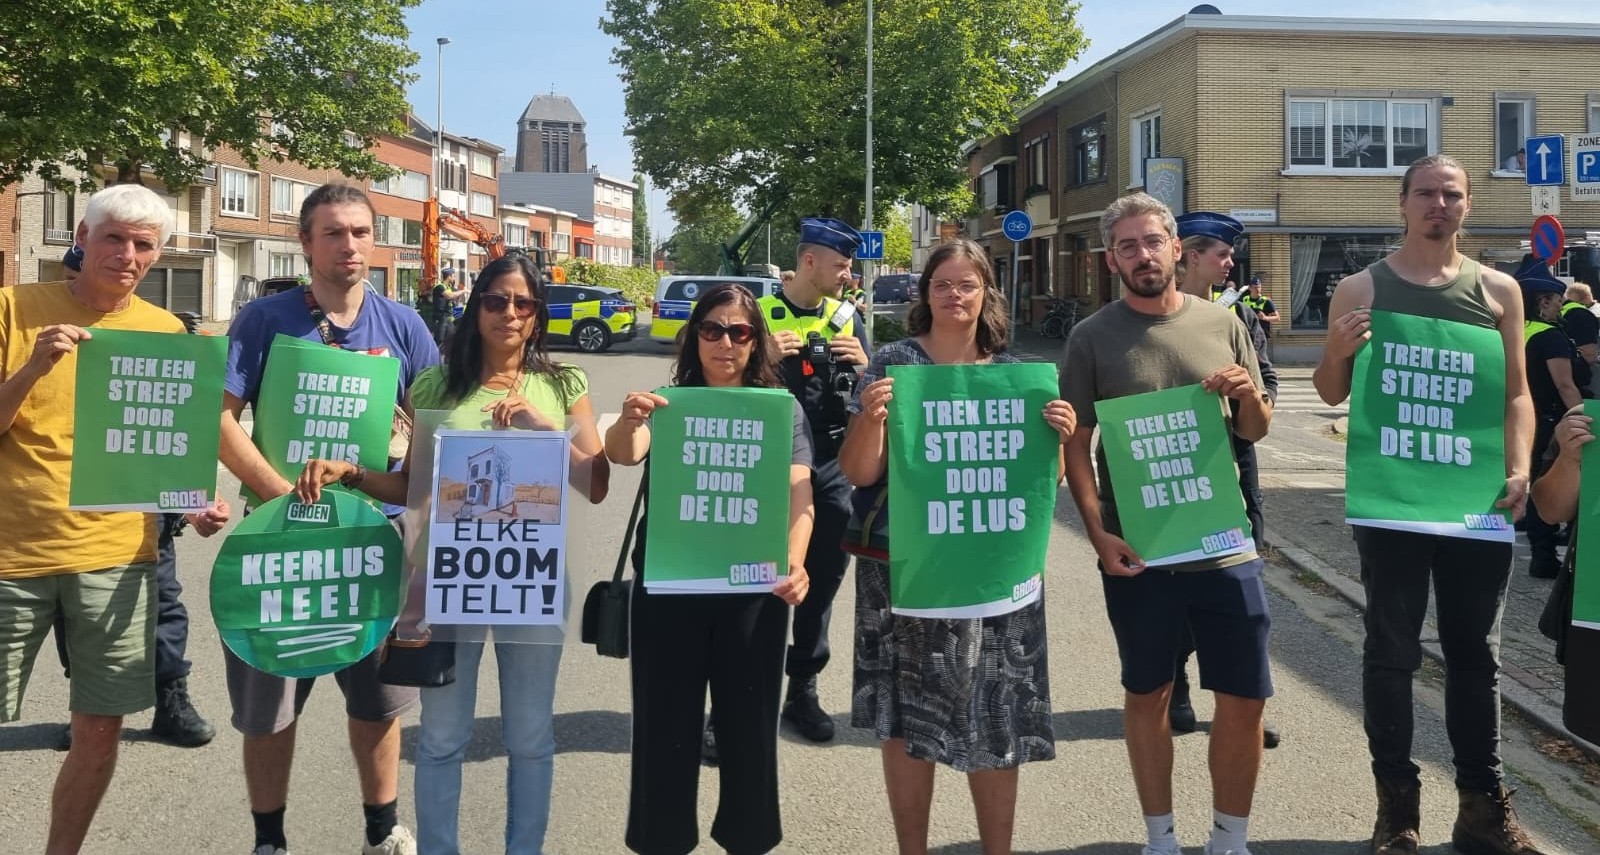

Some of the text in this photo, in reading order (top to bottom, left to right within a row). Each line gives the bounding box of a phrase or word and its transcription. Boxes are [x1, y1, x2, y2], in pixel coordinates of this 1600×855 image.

[1577, 137, 1600, 147] ZONE
[1582, 154, 1596, 175] P
[110, 356, 196, 380] TREK EEN
[1383, 342, 1474, 375] TREK EEN
[108, 379, 192, 405] STREEP
[297, 372, 371, 396] TREK EEN
[1381, 368, 1473, 404] STREEP
[123, 406, 174, 427] DOOR
[293, 393, 368, 419] STREEP
[923, 399, 1025, 426] TREK EEN
[1398, 401, 1453, 430] DOOR
[303, 419, 349, 439] DOOR
[684, 416, 764, 441] TREK EEN
[1125, 409, 1198, 437] TREK EEN
[105, 428, 188, 456] DE LUS
[286, 440, 315, 464] DE
[682, 441, 762, 468] STREEP
[924, 429, 1025, 462] STREEP
[1130, 430, 1201, 461] STREEP
[1380, 426, 1472, 467] DE LUS
[696, 470, 745, 493] DOOR
[946, 467, 1007, 494] DOOR
[1149, 457, 1194, 480] DOOR
[159, 490, 208, 508] GROEN
[1141, 476, 1213, 509] DE LUS
[290, 504, 329, 521] GROEN
[680, 495, 759, 525] DE LUS
[927, 498, 1026, 535] DE LUS
[454, 518, 541, 542] ELKE
[241, 545, 384, 586] KEERLUS
[433, 546, 559, 580] BOOM
[730, 563, 777, 584] GROEN
[433, 584, 557, 615] TELT!
